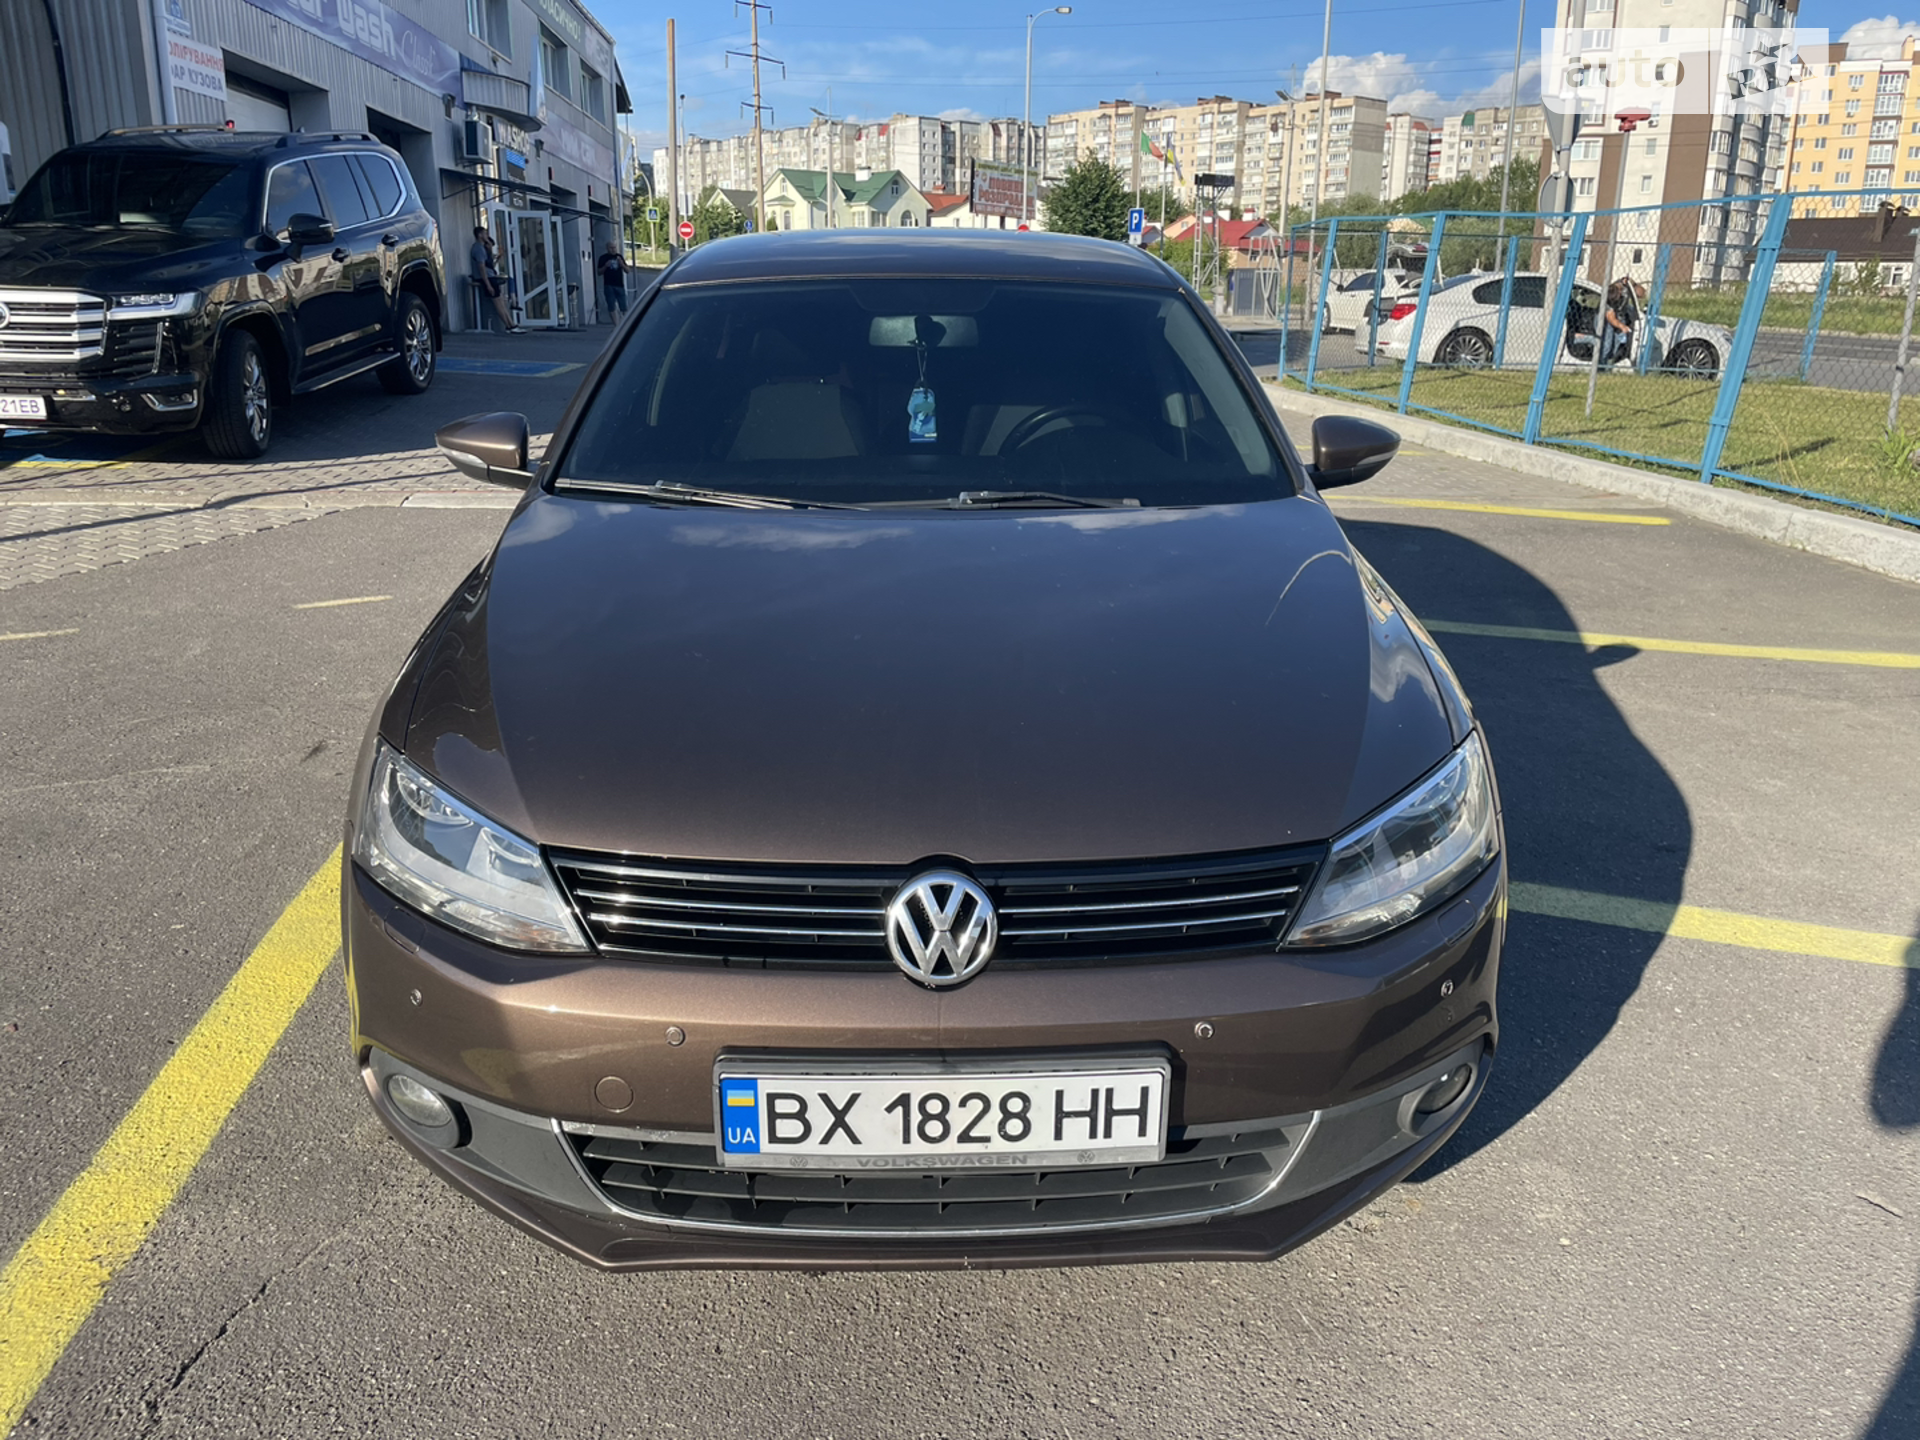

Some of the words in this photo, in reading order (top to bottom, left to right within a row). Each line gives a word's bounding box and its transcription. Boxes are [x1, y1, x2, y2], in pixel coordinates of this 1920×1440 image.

[1131, 212, 1140, 230] P
[766, 1092, 863, 1145] BX
[884, 1091, 1032, 1144] 1828
[1053, 1086, 1150, 1141] HH
[728, 1127, 756, 1144] UA
[857, 1154, 1028, 1168] VOLKSWAGEN
